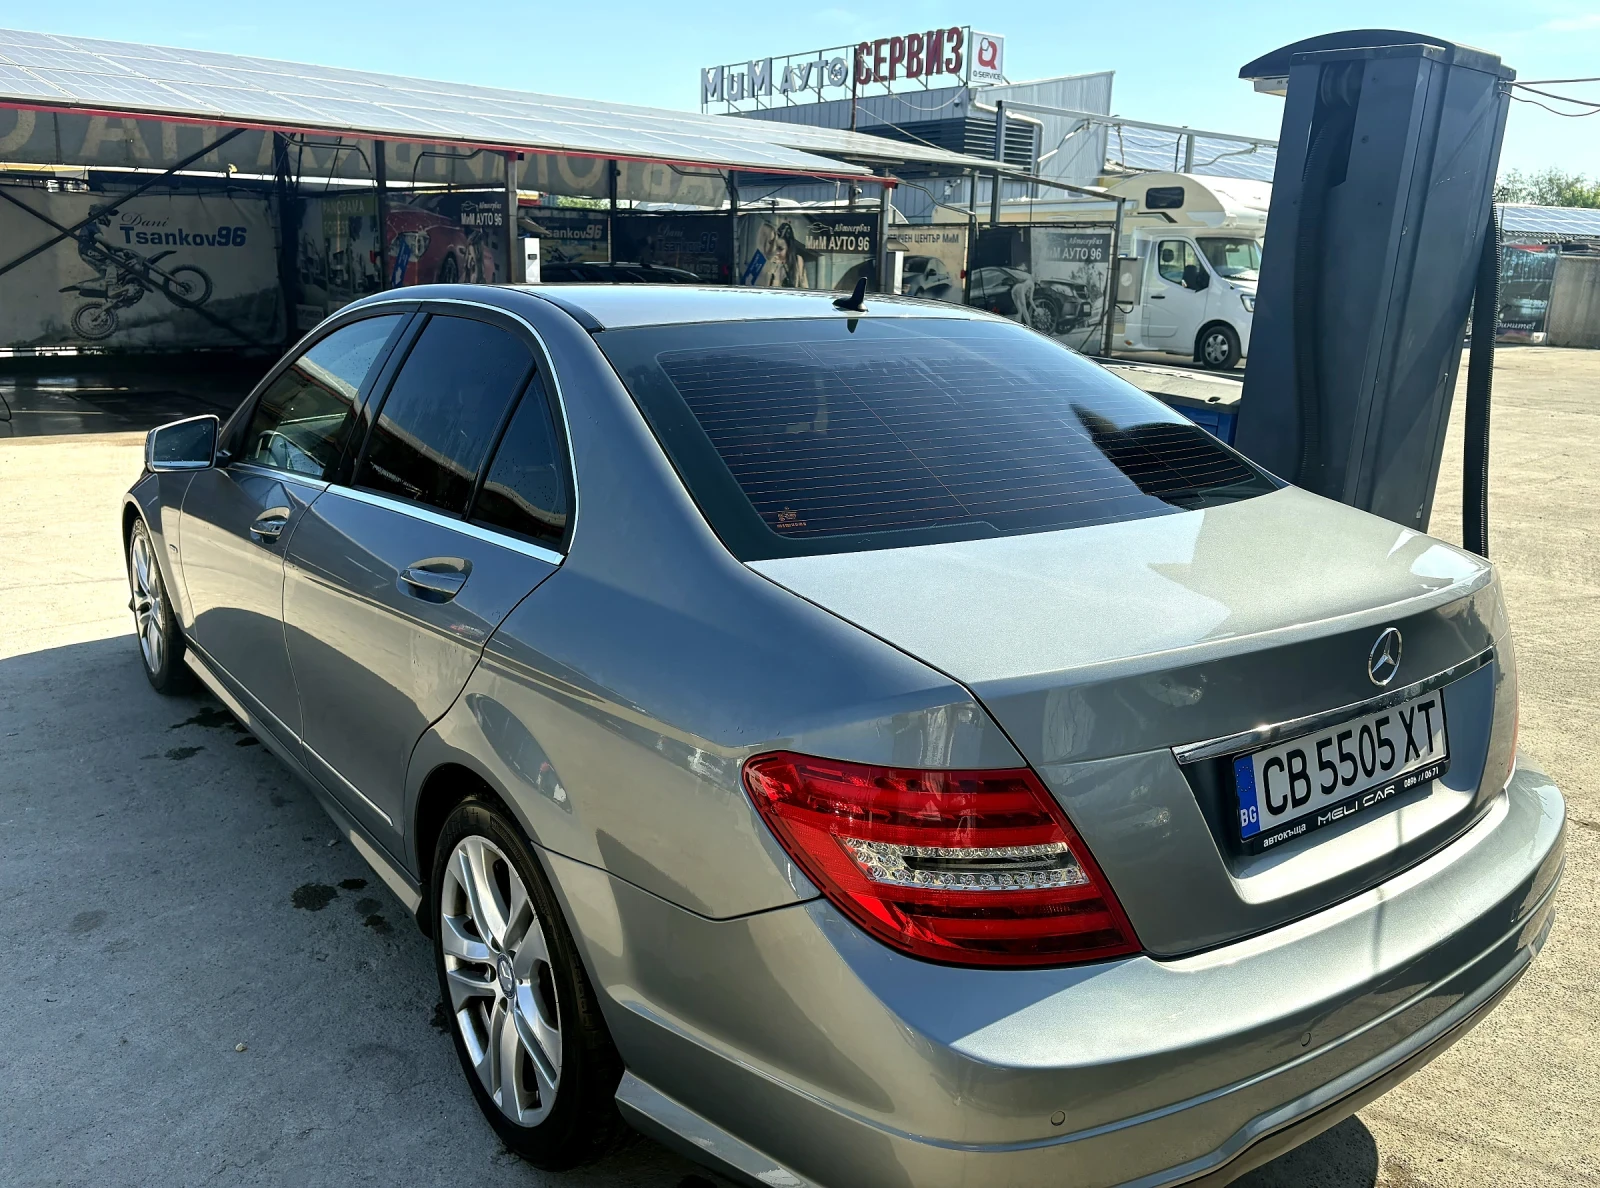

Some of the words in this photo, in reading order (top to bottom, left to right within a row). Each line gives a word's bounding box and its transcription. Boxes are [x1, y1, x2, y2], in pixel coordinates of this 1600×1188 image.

[855, 26, 964, 85] СЕРВИЗ
[978, 70, 1002, 80] SERVICE
[322, 199, 365, 214] PANORAMA
[120, 211, 170, 227] Dani
[476, 212, 493, 226] АУТО
[494, 213, 502, 226] 96
[120, 225, 247, 247] Tsankov96
[323, 221, 350, 235] FOREST
[541, 223, 603, 239] sankov96
[805, 235, 827, 249] МиМ
[828, 236, 856, 251] АУТО
[857, 236, 870, 251] 96
[914, 233, 941, 244] ЦЕНТЪР
[1062, 247, 1088, 260] АУТО
[1090, 247, 1102, 260] 96
[1241, 805, 1258, 827] BG
[1263, 748, 1312, 816] CB
[1316, 716, 1395, 795] 5505
[1398, 700, 1436, 764] XT
[1317, 801, 1359, 826] MELI
[1362, 785, 1396, 807] CAR
[1263, 823, 1307, 848] автокъща
